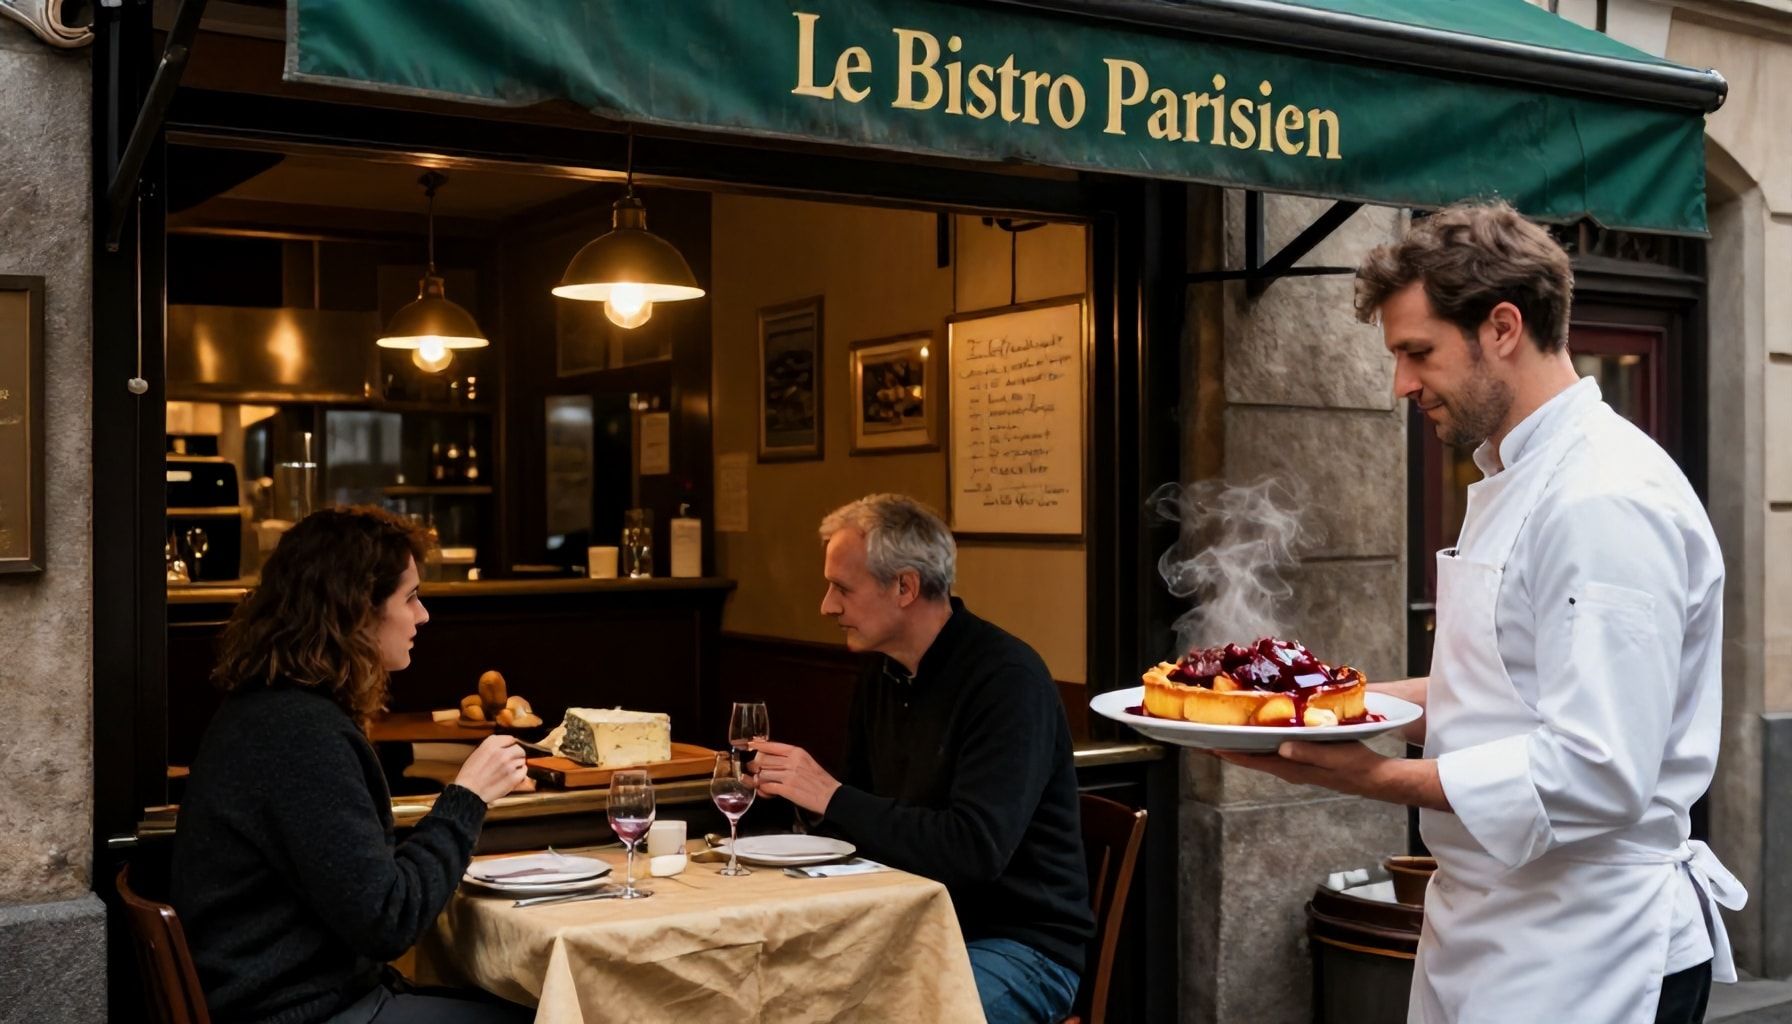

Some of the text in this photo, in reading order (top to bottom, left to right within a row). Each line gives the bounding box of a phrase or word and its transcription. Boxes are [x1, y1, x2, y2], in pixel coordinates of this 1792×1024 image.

[793, 12, 1342, 160] Le Bistro Parisien
